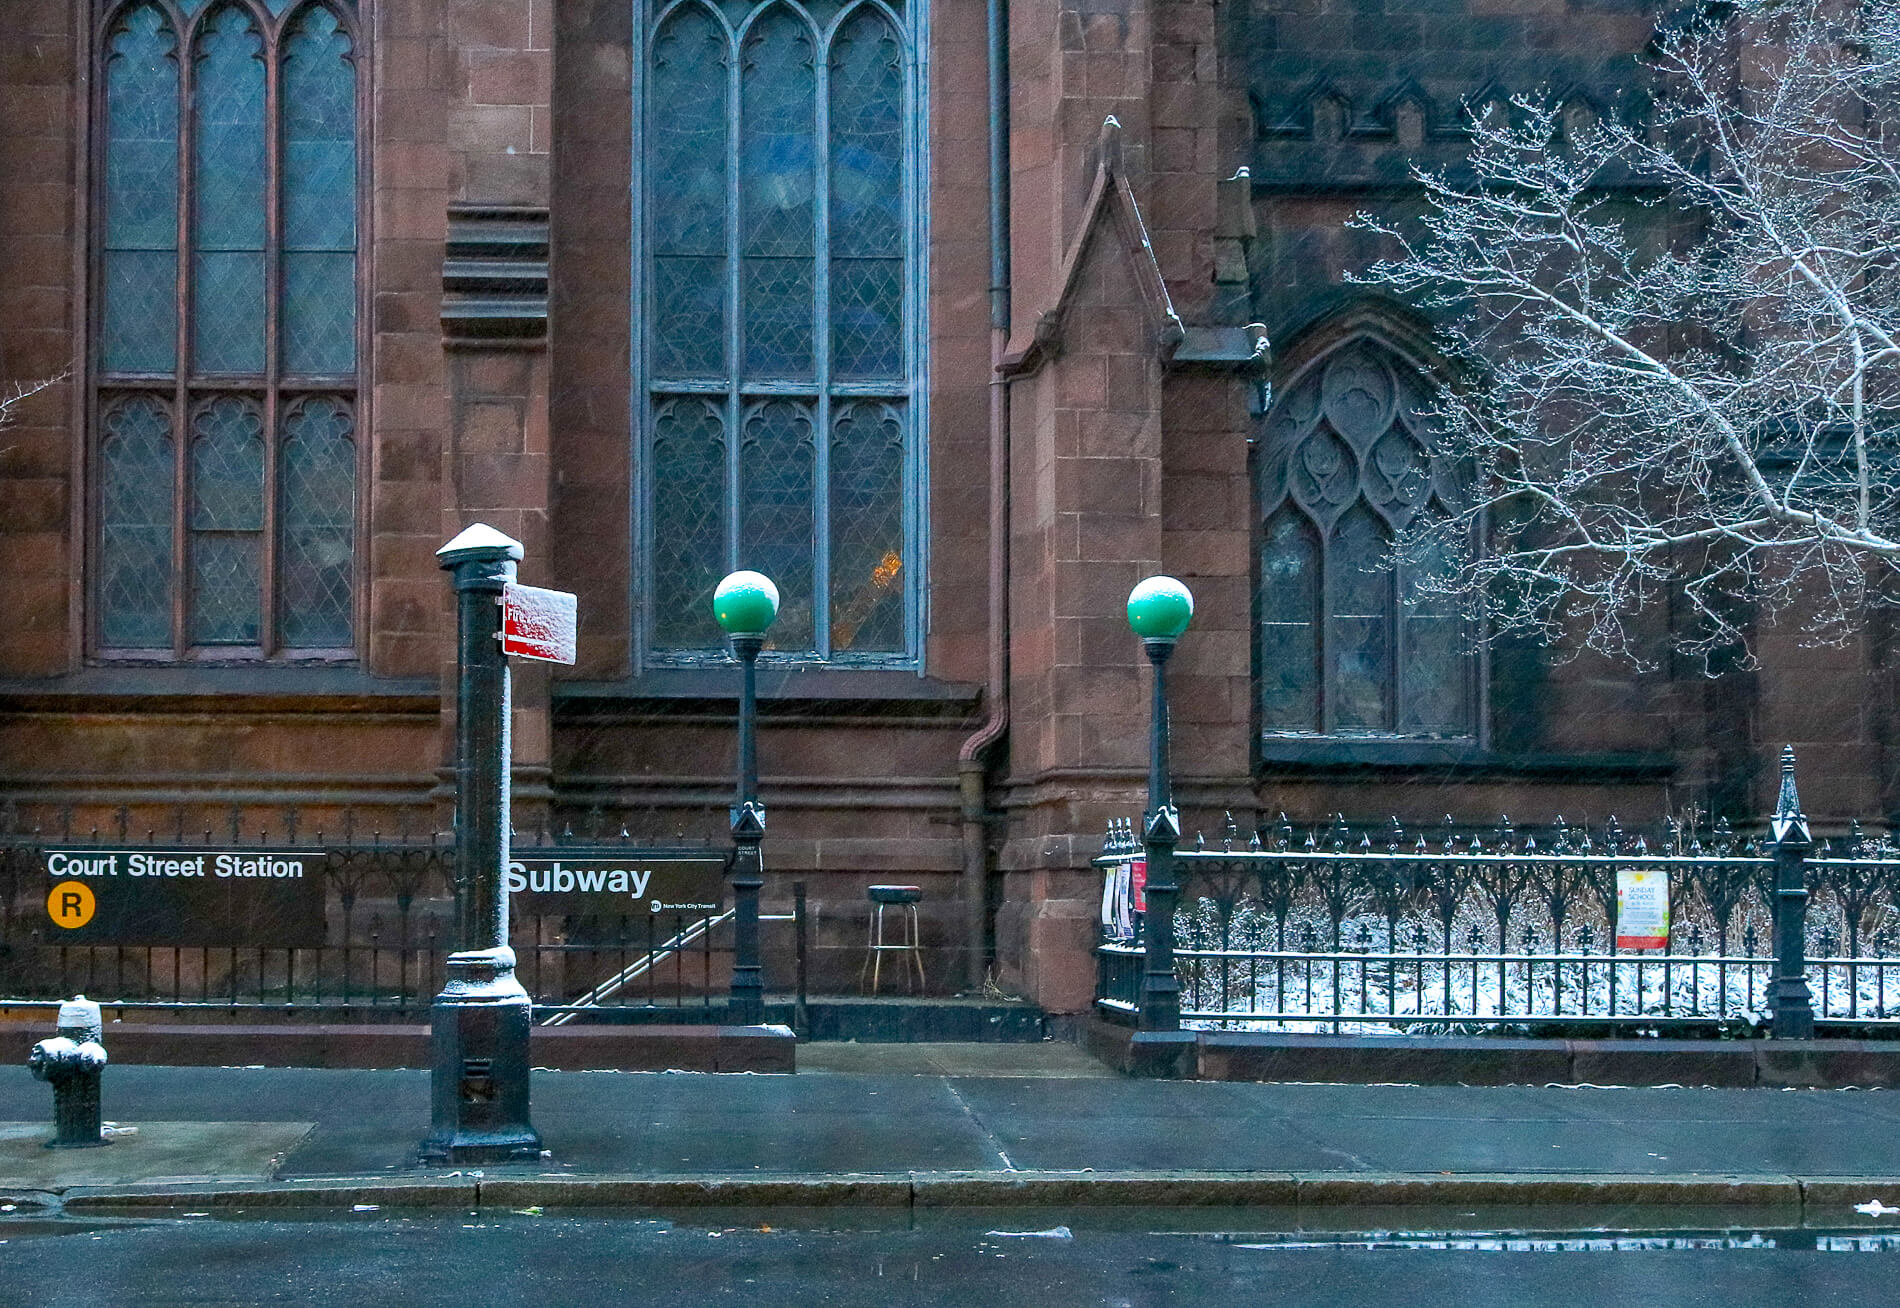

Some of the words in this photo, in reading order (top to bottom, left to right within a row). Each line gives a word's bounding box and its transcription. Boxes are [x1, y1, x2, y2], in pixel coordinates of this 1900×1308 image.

[47, 853, 118, 876] Court
[127, 854, 205, 877] Street
[214, 854, 303, 878] Station
[508, 861, 652, 899] Subway
[61, 892, 82, 917] R
